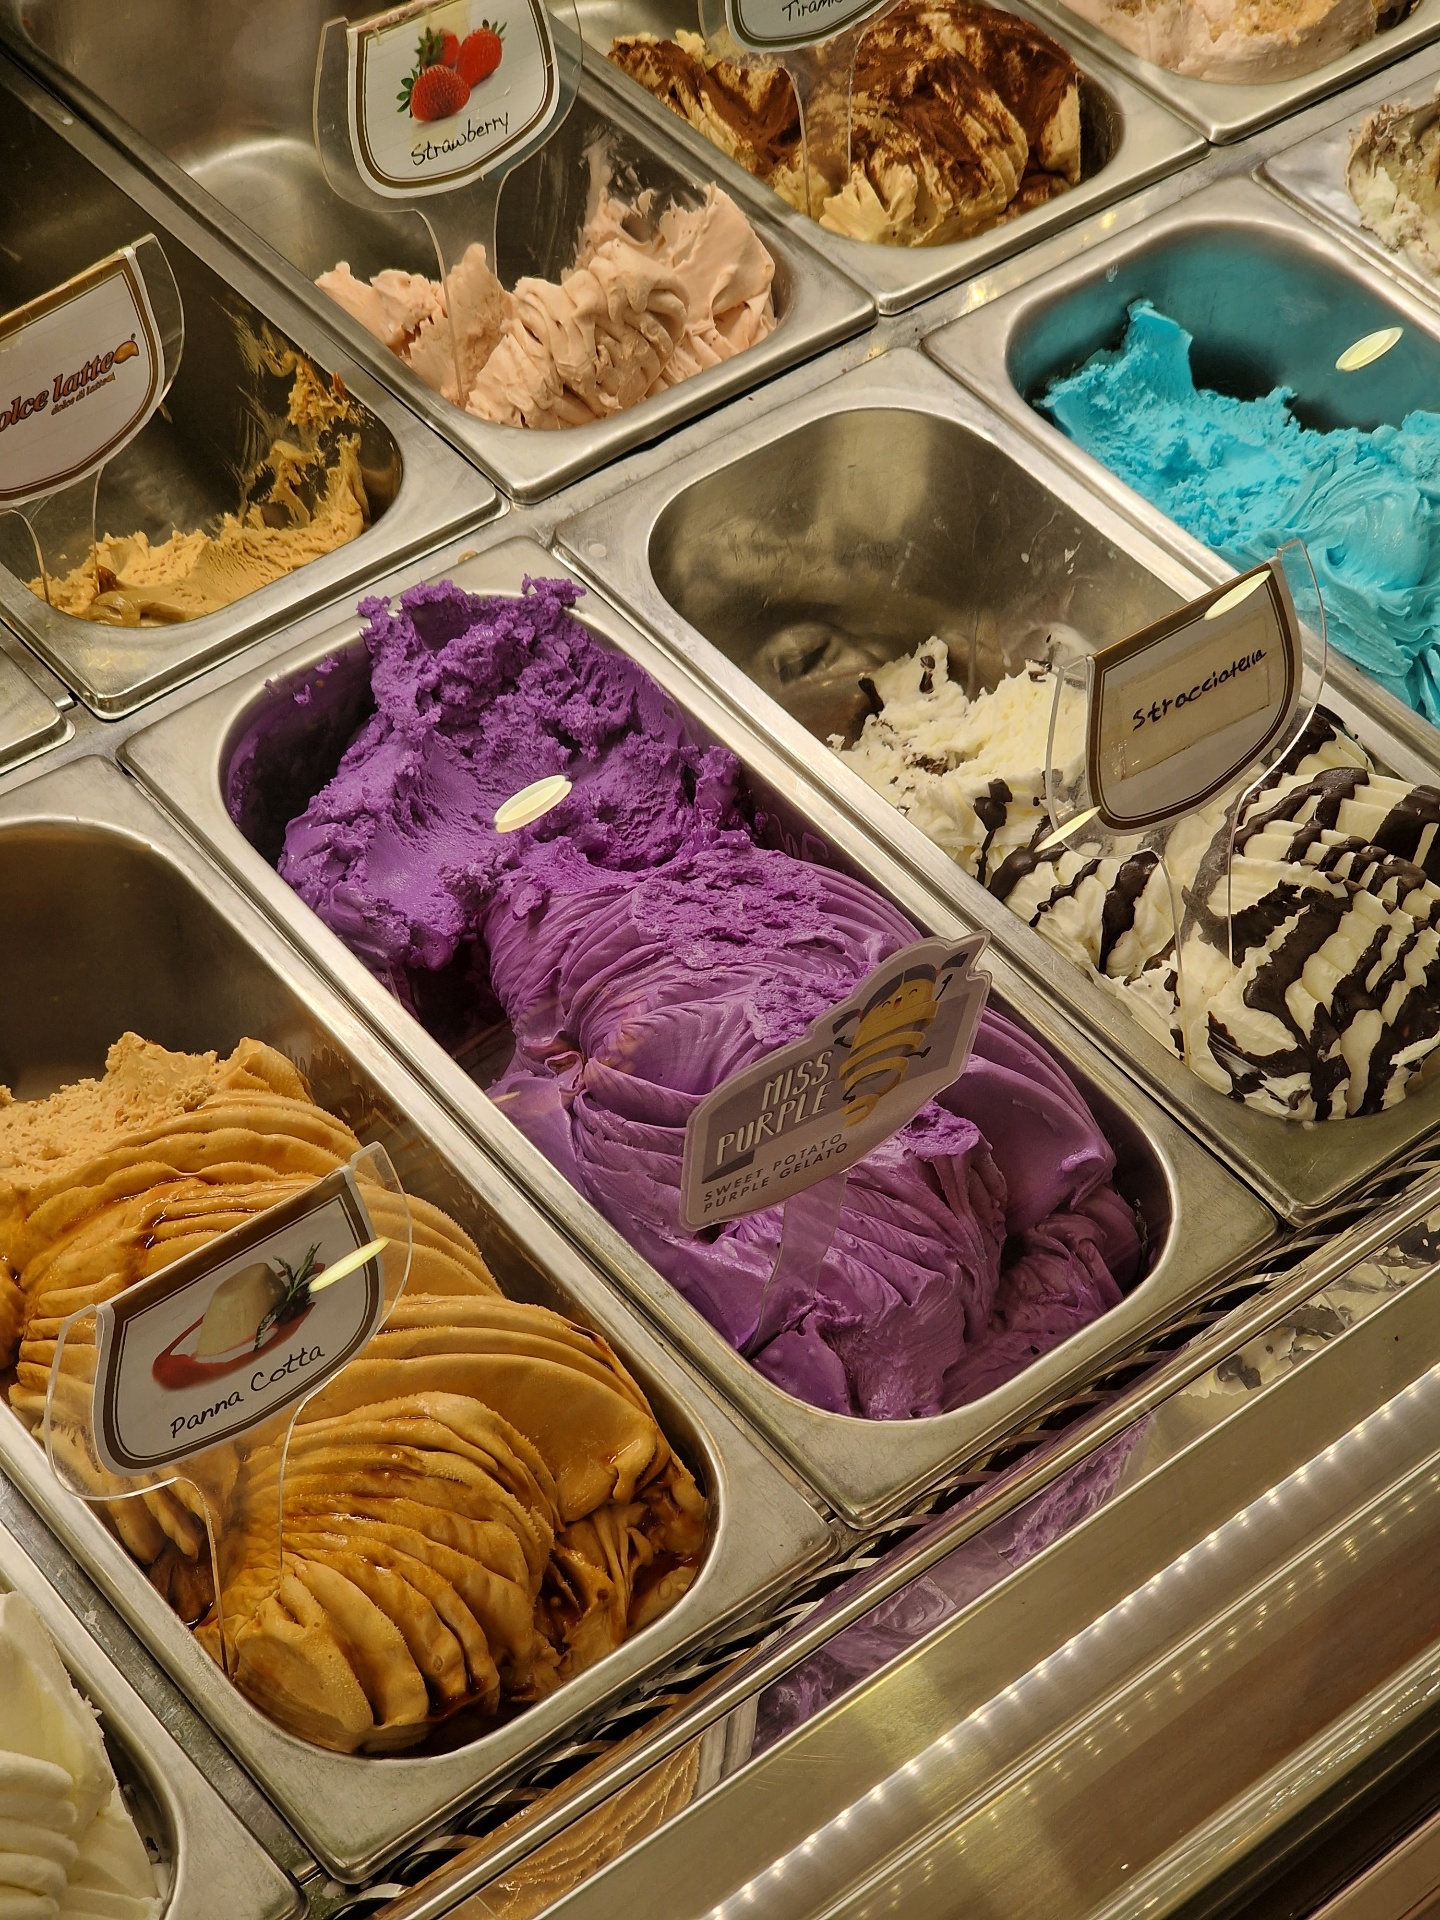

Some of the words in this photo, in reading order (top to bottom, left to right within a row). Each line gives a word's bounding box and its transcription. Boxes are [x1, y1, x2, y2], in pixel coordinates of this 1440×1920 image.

[781, 0, 843, 22] Tiram
[411, 111, 509, 166] Strawberry
[0, 390, 49, 433] olce
[53, 351, 115, 403] latte
[761, 1050, 833, 1111] MISS
[716, 1080, 835, 1166] PURPLE
[703, 1168, 764, 1202] SWEET
[773, 1133, 843, 1172] POTATO
[703, 1176, 769, 1213] PURPLE
[779, 1142, 848, 1180] GELATO
[170, 1391, 244, 1439] Panna
[250, 1345, 325, 1392] Cotta
